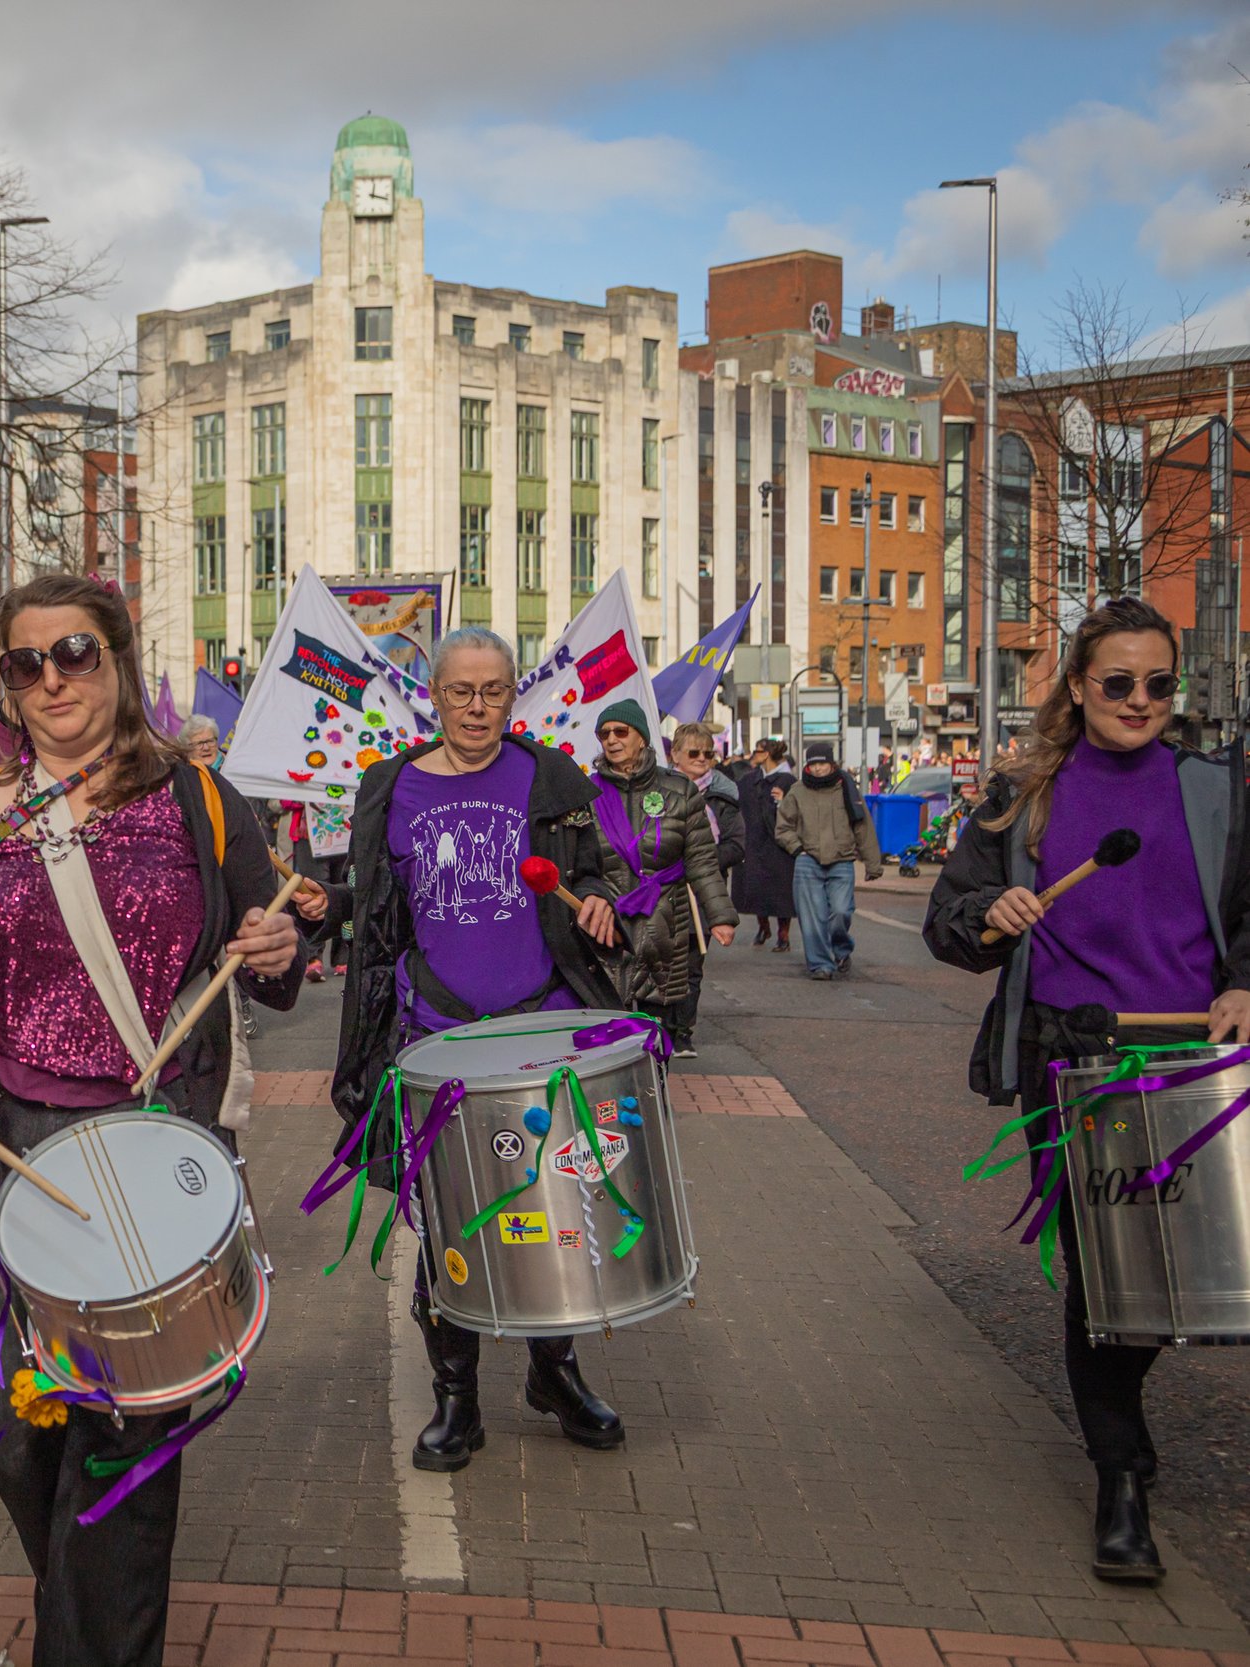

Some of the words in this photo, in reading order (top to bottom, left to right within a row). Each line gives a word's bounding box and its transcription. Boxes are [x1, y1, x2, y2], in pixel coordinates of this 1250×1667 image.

[296, 645, 367, 690] REVOLUTION
[322, 649, 342, 668] THE
[299, 658, 326, 679] WILL
[326, 673, 350, 692] NOT
[300, 669, 348, 702] KNITTED
[408, 811, 428, 830] THEY
[430, 802, 458, 815] CAN'T
[461, 800, 489, 809] BURN
[491, 802, 505, 812] US
[507, 807, 523, 819] ALL
[177, 1161, 203, 1192] IZZO
[584, 1156, 617, 1180] ligt
